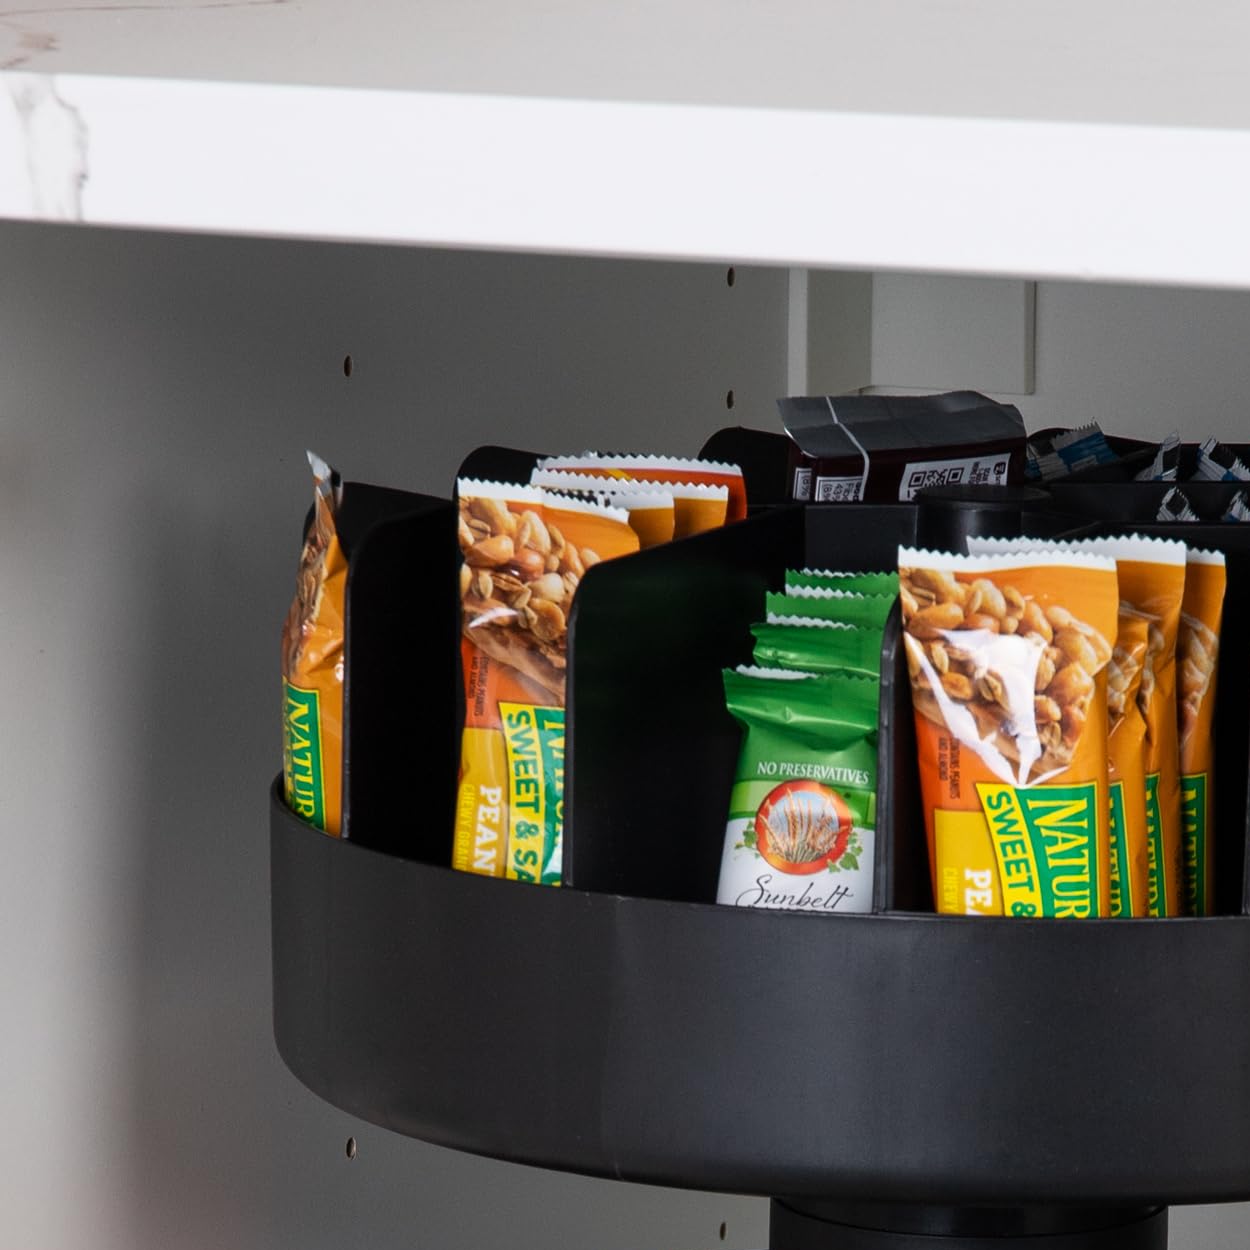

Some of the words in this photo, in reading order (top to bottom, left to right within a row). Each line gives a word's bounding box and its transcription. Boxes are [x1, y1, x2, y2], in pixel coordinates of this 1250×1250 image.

[507, 709, 541, 816] SWEET
[757, 761, 777, 775] NO
[779, 762, 869, 784] PRESERVATIVES
[515, 821, 540, 840] &
[987, 791, 1034, 894] SWEET
[736, 874, 854, 909] Sunbelt
